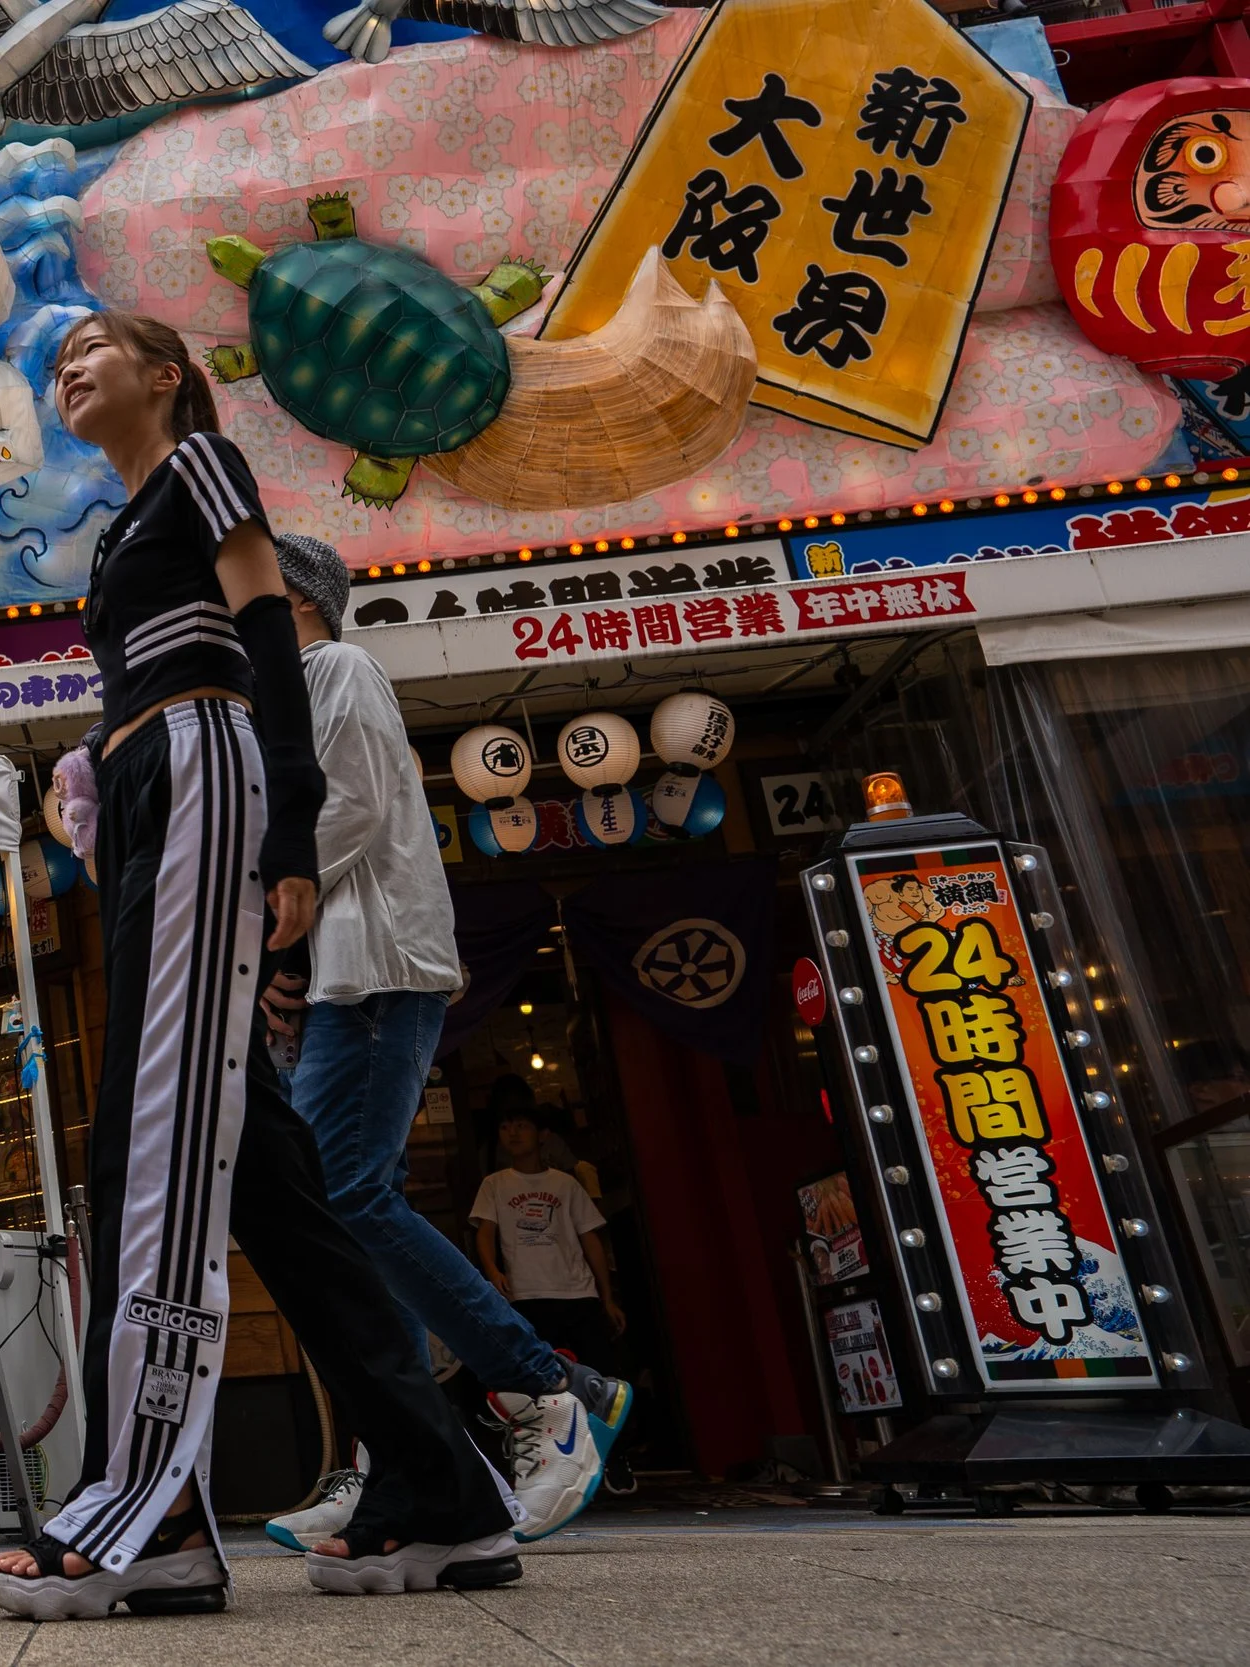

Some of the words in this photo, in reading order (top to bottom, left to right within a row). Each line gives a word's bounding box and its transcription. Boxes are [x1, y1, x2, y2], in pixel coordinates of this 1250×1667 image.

[661, 73, 821, 284] 大阪
[772, 66, 968, 370] 新世界
[805, 578, 961, 624] 年中無休
[512, 592, 787, 661] 24時間営業
[933, 880, 999, 908] 横綱
[900, 922, 1088, 1340] 24時間営業中
[508, 1193, 527, 1208] TOM
[538, 1192, 562, 1208] JERRY
[130, 1302, 216, 1337] adidas
[151, 1367, 184, 1382] BRAND
